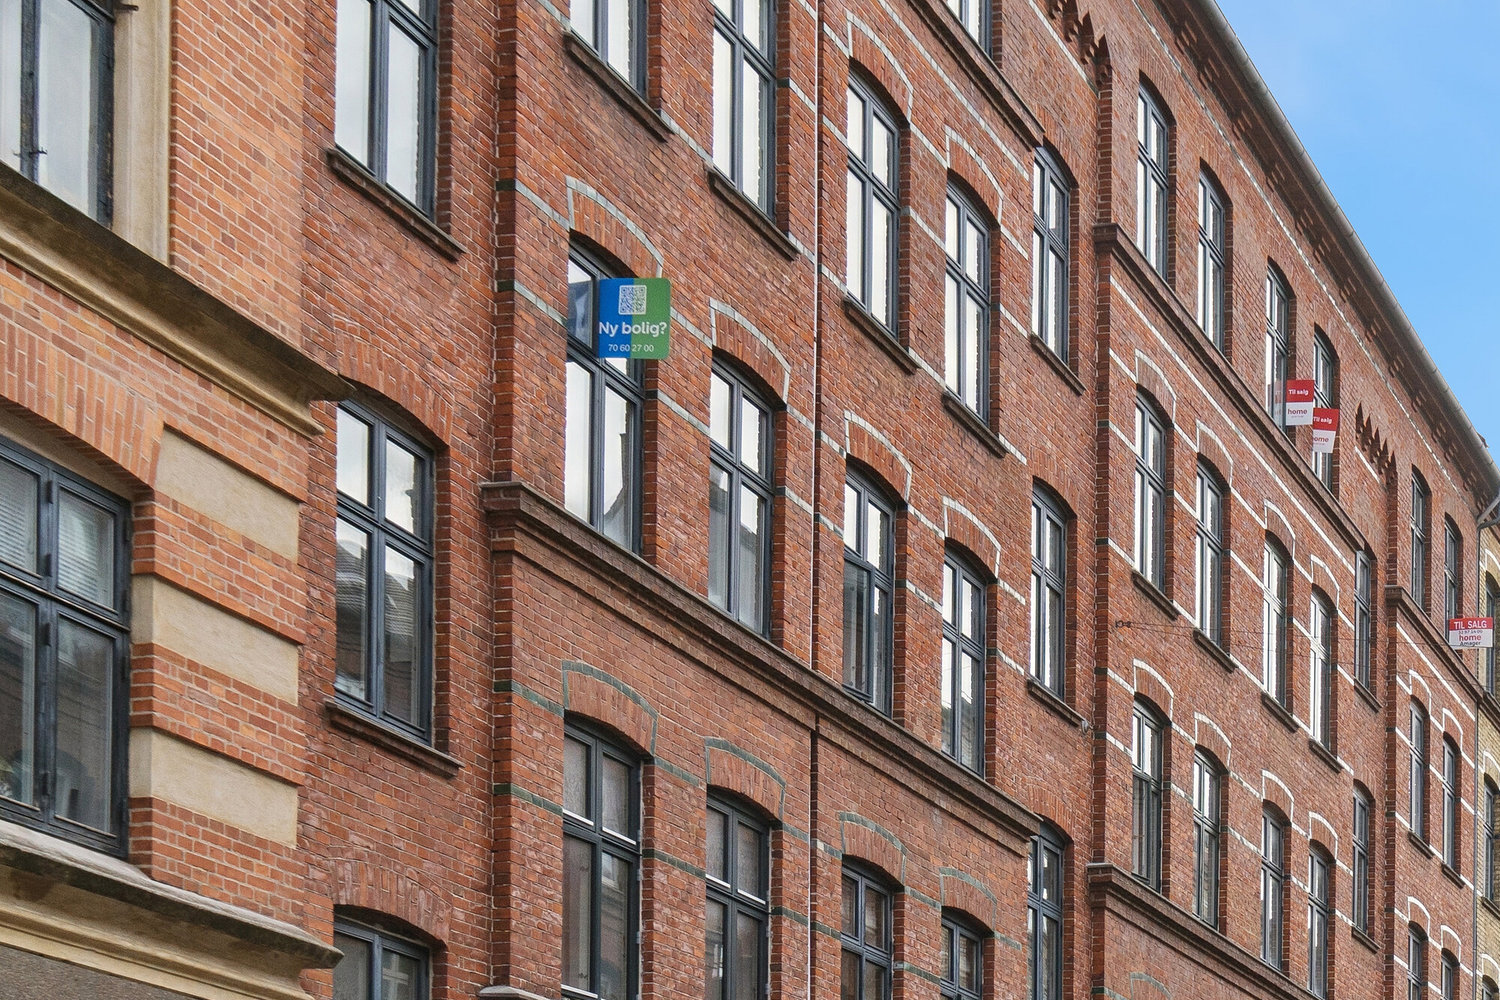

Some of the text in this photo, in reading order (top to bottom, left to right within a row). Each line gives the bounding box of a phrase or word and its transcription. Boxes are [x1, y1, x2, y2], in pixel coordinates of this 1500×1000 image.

[599, 322, 668, 337] Ny bolig?
[608, 344, 654, 352] 70 60 27 00
[1454, 620, 1487, 630] TIL SALG
